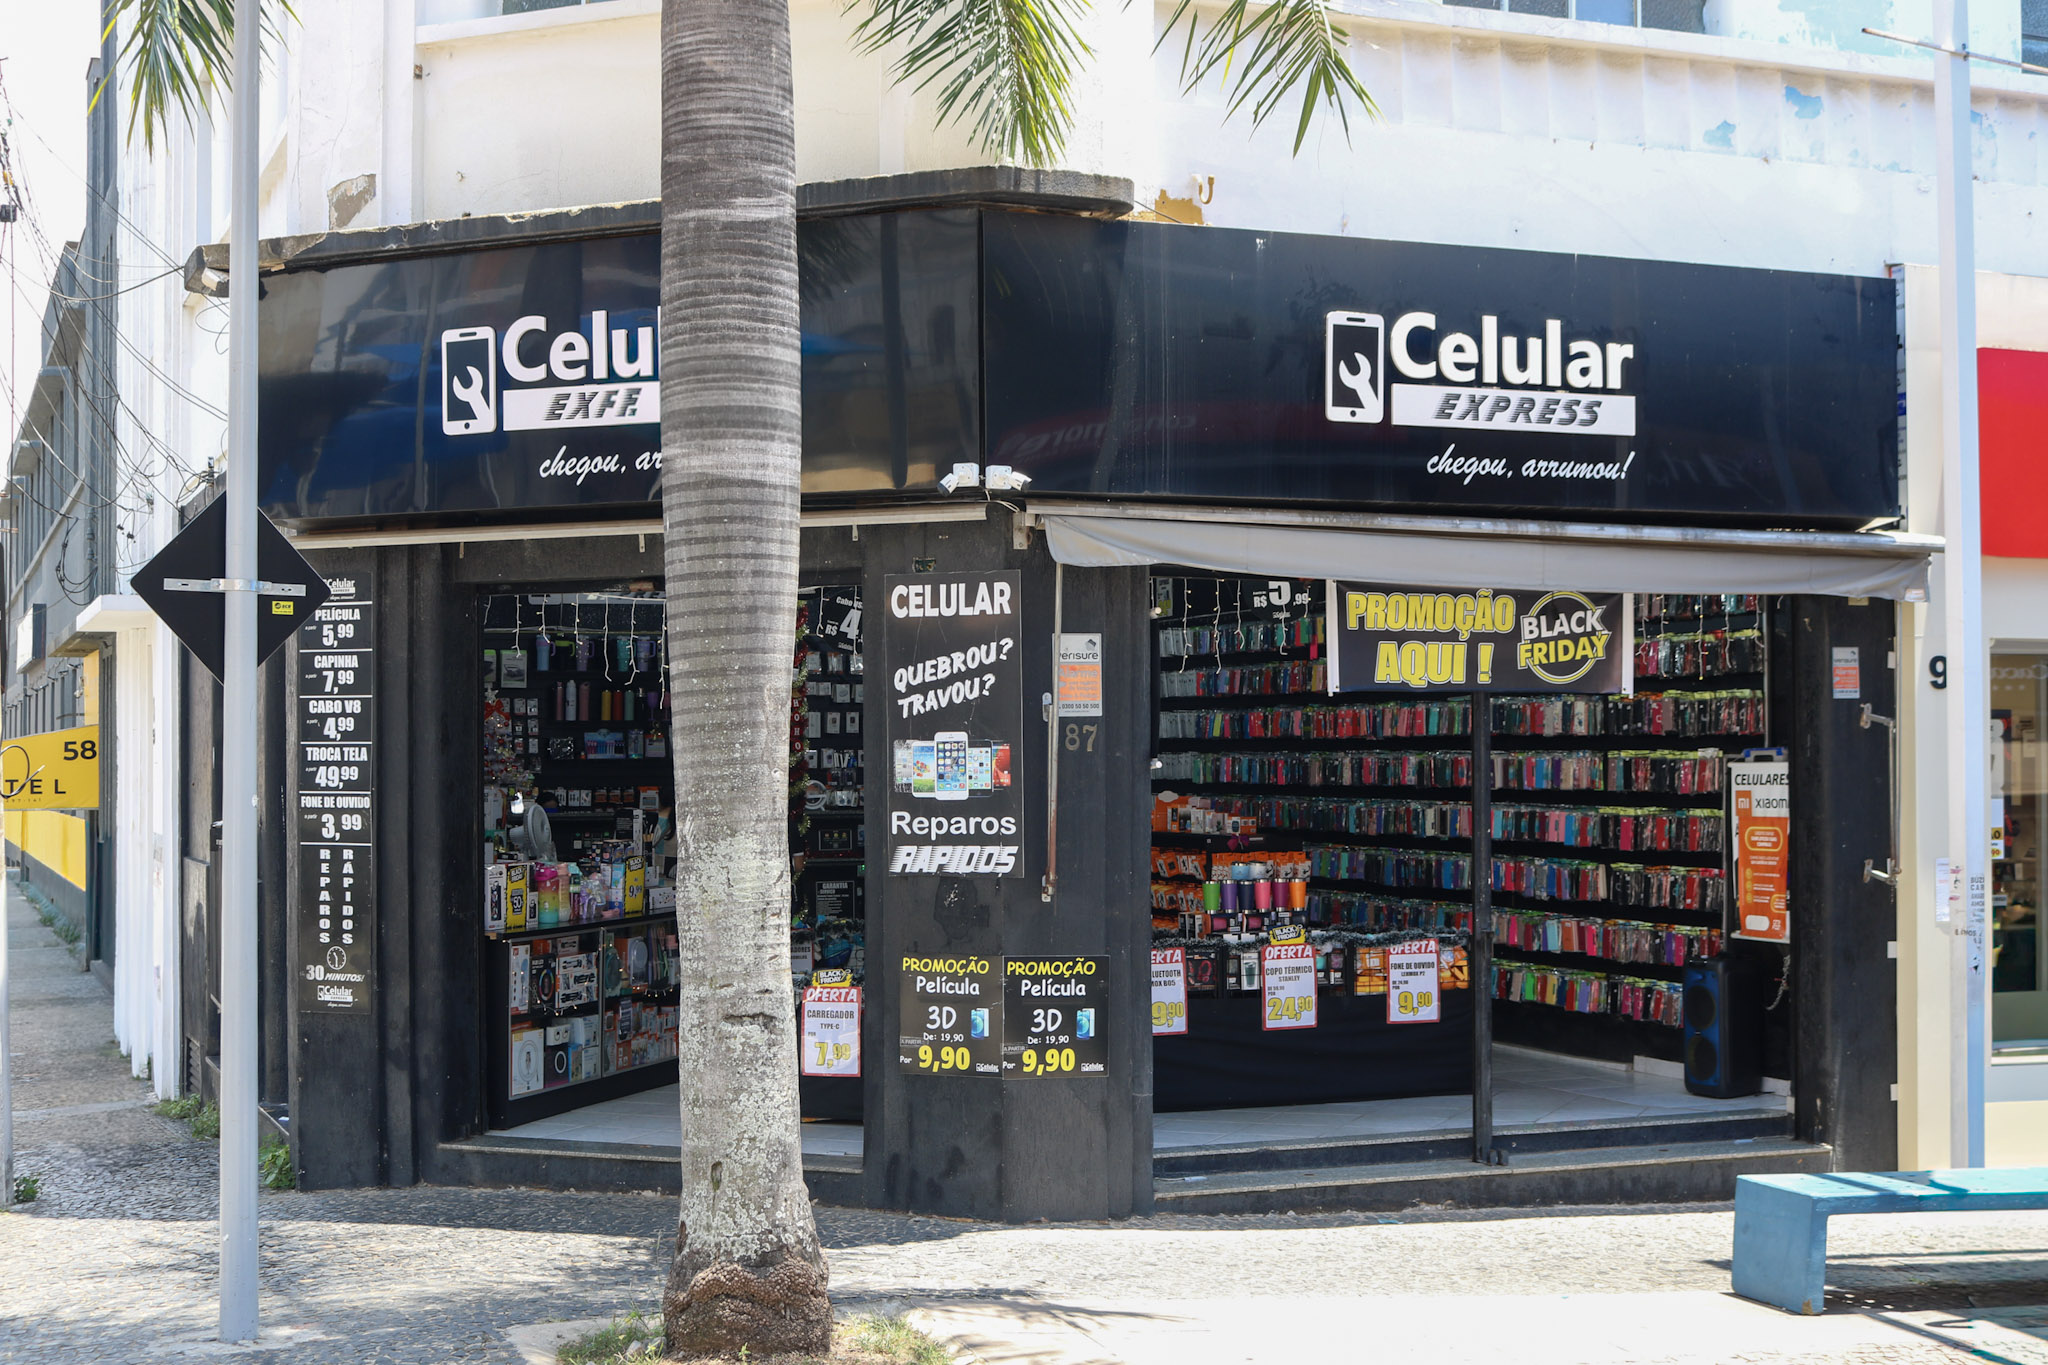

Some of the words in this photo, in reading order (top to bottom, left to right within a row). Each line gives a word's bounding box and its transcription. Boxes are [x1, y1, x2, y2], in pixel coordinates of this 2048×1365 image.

[502, 306, 661, 382] Celu
[1390, 312, 1634, 389] Celular
[1432, 393, 1602, 426] EXPRESS
[539, 445, 626, 486] chegou,
[1426, 443, 1513, 485] chegou,
[1522, 451, 1635, 480] arrumou!
[891, 582, 1011, 618] CELULAR
[1254, 595, 1267, 608] R$
[315, 607, 360, 621] PELÍCULA
[1346, 589, 1516, 641] PROMOÇÃO
[1521, 606, 1606, 640] BLACK
[322, 624, 354, 648] 5,99
[825, 624, 838, 636] R$
[314, 655, 358, 668] CAPINHA
[1518, 632, 1612, 669] FRIDAY
[894, 637, 1013, 693] QUEBROU?
[1375, 641, 1467, 687] AQUI
[322, 670, 354, 694] 7,99
[309, 700, 342, 714] CABO
[344, 700, 361, 714] V8
[897, 673, 996, 719] TRAVOU?
[323, 717, 354, 741] 4,99
[1065, 723, 1098, 752] 87
[63, 740, 97, 760] 58
[306, 747, 341, 761] TROCA
[343, 747, 368, 761] TELA
[315, 766, 359, 789] 49,99
[301, 796, 322, 808] FONE
[324, 796, 335, 808] DE
[336, 796, 370, 808] OUVIDO
[321, 813, 362, 841] 3,99
[892, 811, 1016, 840] Reparos
[319, 849, 331, 944] REPAROS
[1151, 949, 1181, 963] ERTA
[1265, 945, 1312, 959] OFERTA
[1390, 940, 1435, 954] OFERTA
[306, 965, 324, 980] 30
[325, 972, 365, 982] MINUTOS!
[902, 956, 989, 976] PROMOÇÃO
[1007, 958, 1096, 978] PROMOÇÃO
[1152, 970, 1181, 978] LUETOOTH
[1265, 967, 1282, 976] COPO
[1284, 965, 1312, 974] TÉRMICO
[325, 986, 352, 995] Celular
[806, 988, 857, 1002] OFERTA
[916, 976, 980, 995] Película
[1021, 978, 1086, 996] Película
[807, 1010, 854, 1019] CARREGADOR
[1268, 996, 1313, 1021] 24,90
[1398, 991, 1432, 1016] 9,90
[926, 1006, 957, 1029] 3D
[1031, 1008, 1062, 1033] 3D
[923, 1033, 936, 1041] De:
[940, 1034, 964, 1042] 19,90
[1028, 1036, 1041, 1044] De:
[1045, 1035, 1069, 1045] 19,90
[814, 1042, 850, 1069] 7,99
[900, 1056, 912, 1064] Por
[918, 1045, 971, 1072] 9,90
[1002, 1061, 1016, 1069] Por
[1022, 1048, 1075, 1075] 9,90
